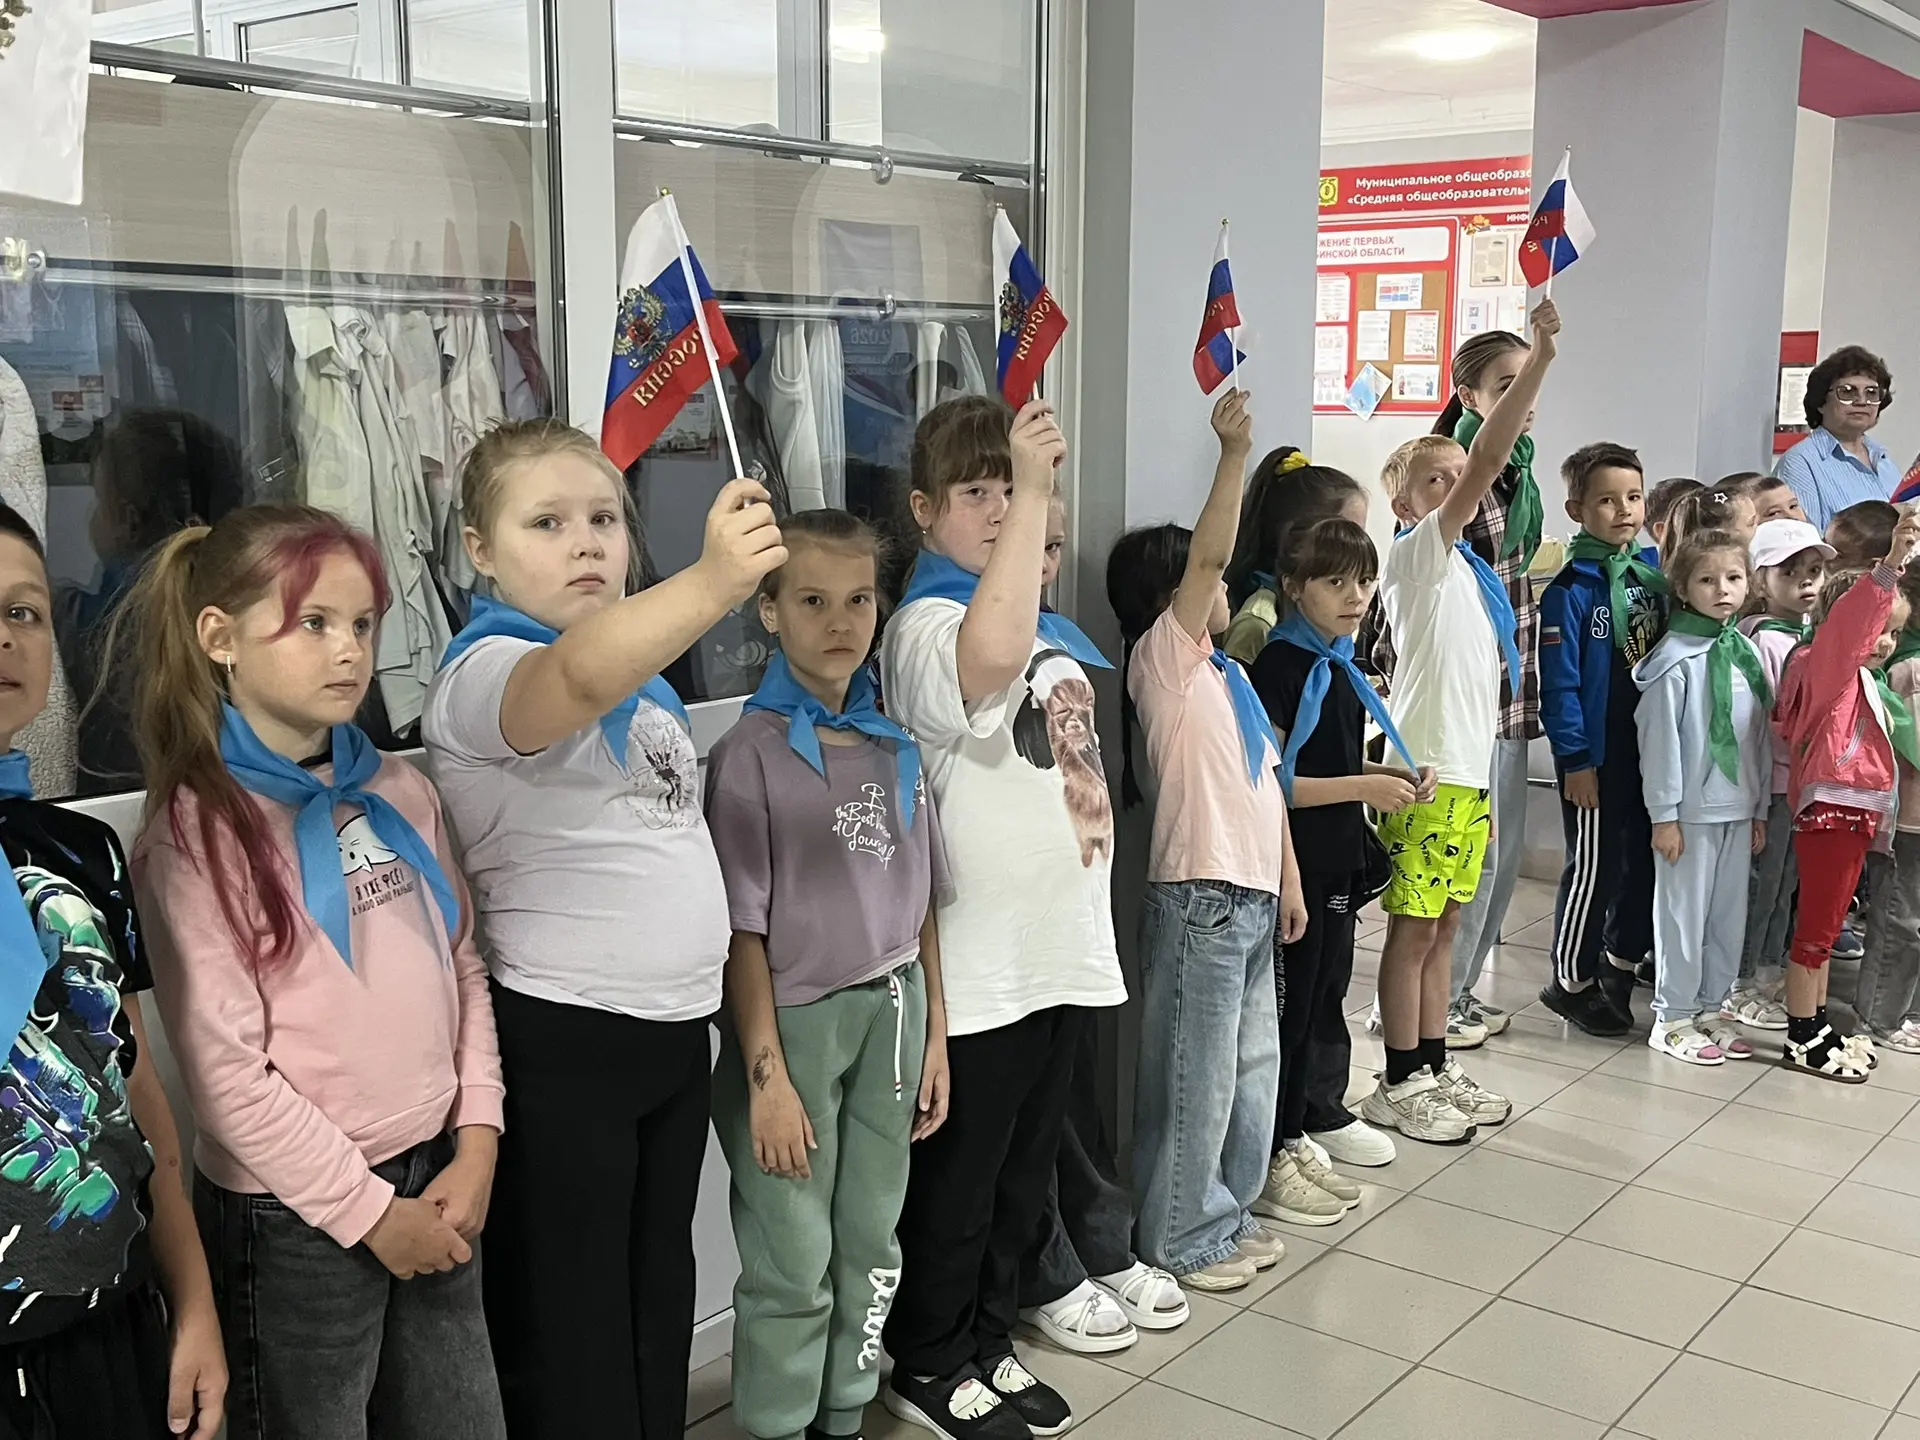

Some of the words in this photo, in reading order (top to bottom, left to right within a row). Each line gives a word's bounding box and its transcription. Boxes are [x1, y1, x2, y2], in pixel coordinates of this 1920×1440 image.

[1356, 174, 1452, 190] Муниципальное
[1347, 193, 1403, 206] «Средняя
[1506, 212, 1529, 222] ИНФ
[1354, 236, 1394, 245] ПЕРВЫХ
[1318, 247, 1357, 258] ИНСКОЙ
[1360, 247, 1405, 257] ОБЛАСТИ
